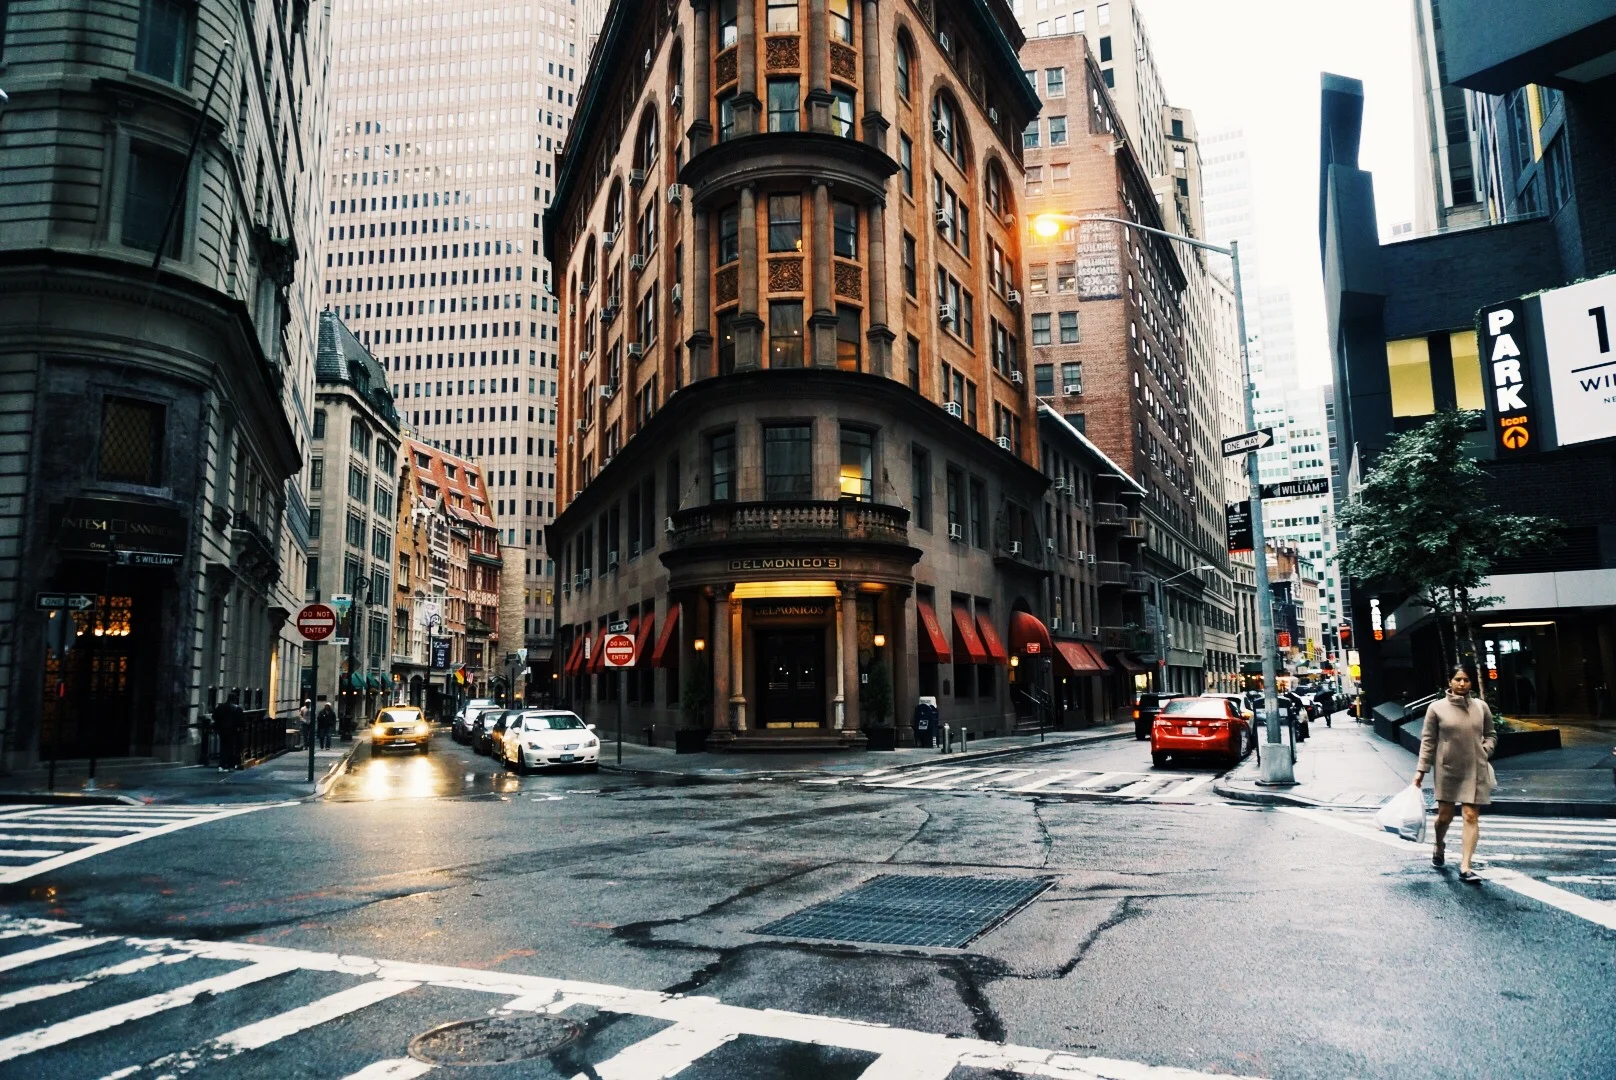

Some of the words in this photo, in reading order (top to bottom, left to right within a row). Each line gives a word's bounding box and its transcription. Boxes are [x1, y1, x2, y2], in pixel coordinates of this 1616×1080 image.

[1077, 242, 1117, 252] BUILDING
[1077, 257, 1118, 267] WELLINGT
[1082, 285, 1117, 295] 7400
[1588, 306, 1610, 354] 1
[1488, 308, 1528, 413] PARK
[1501, 415, 1528, 427] icon
[1227, 441, 1241, 452] ONE
[1244, 436, 1260, 447] WAY
[1281, 482, 1320, 495] WILLIAM
[61, 517, 108, 532] INTESA
[89, 541, 106, 550] One
[142, 556, 174, 566] WILLIAM
[732, 558, 837, 569] DELMONICO'S
[45, 598, 64, 606] ONE
[316, 611, 331, 619] NOT
[304, 627, 328, 635] ENTER
